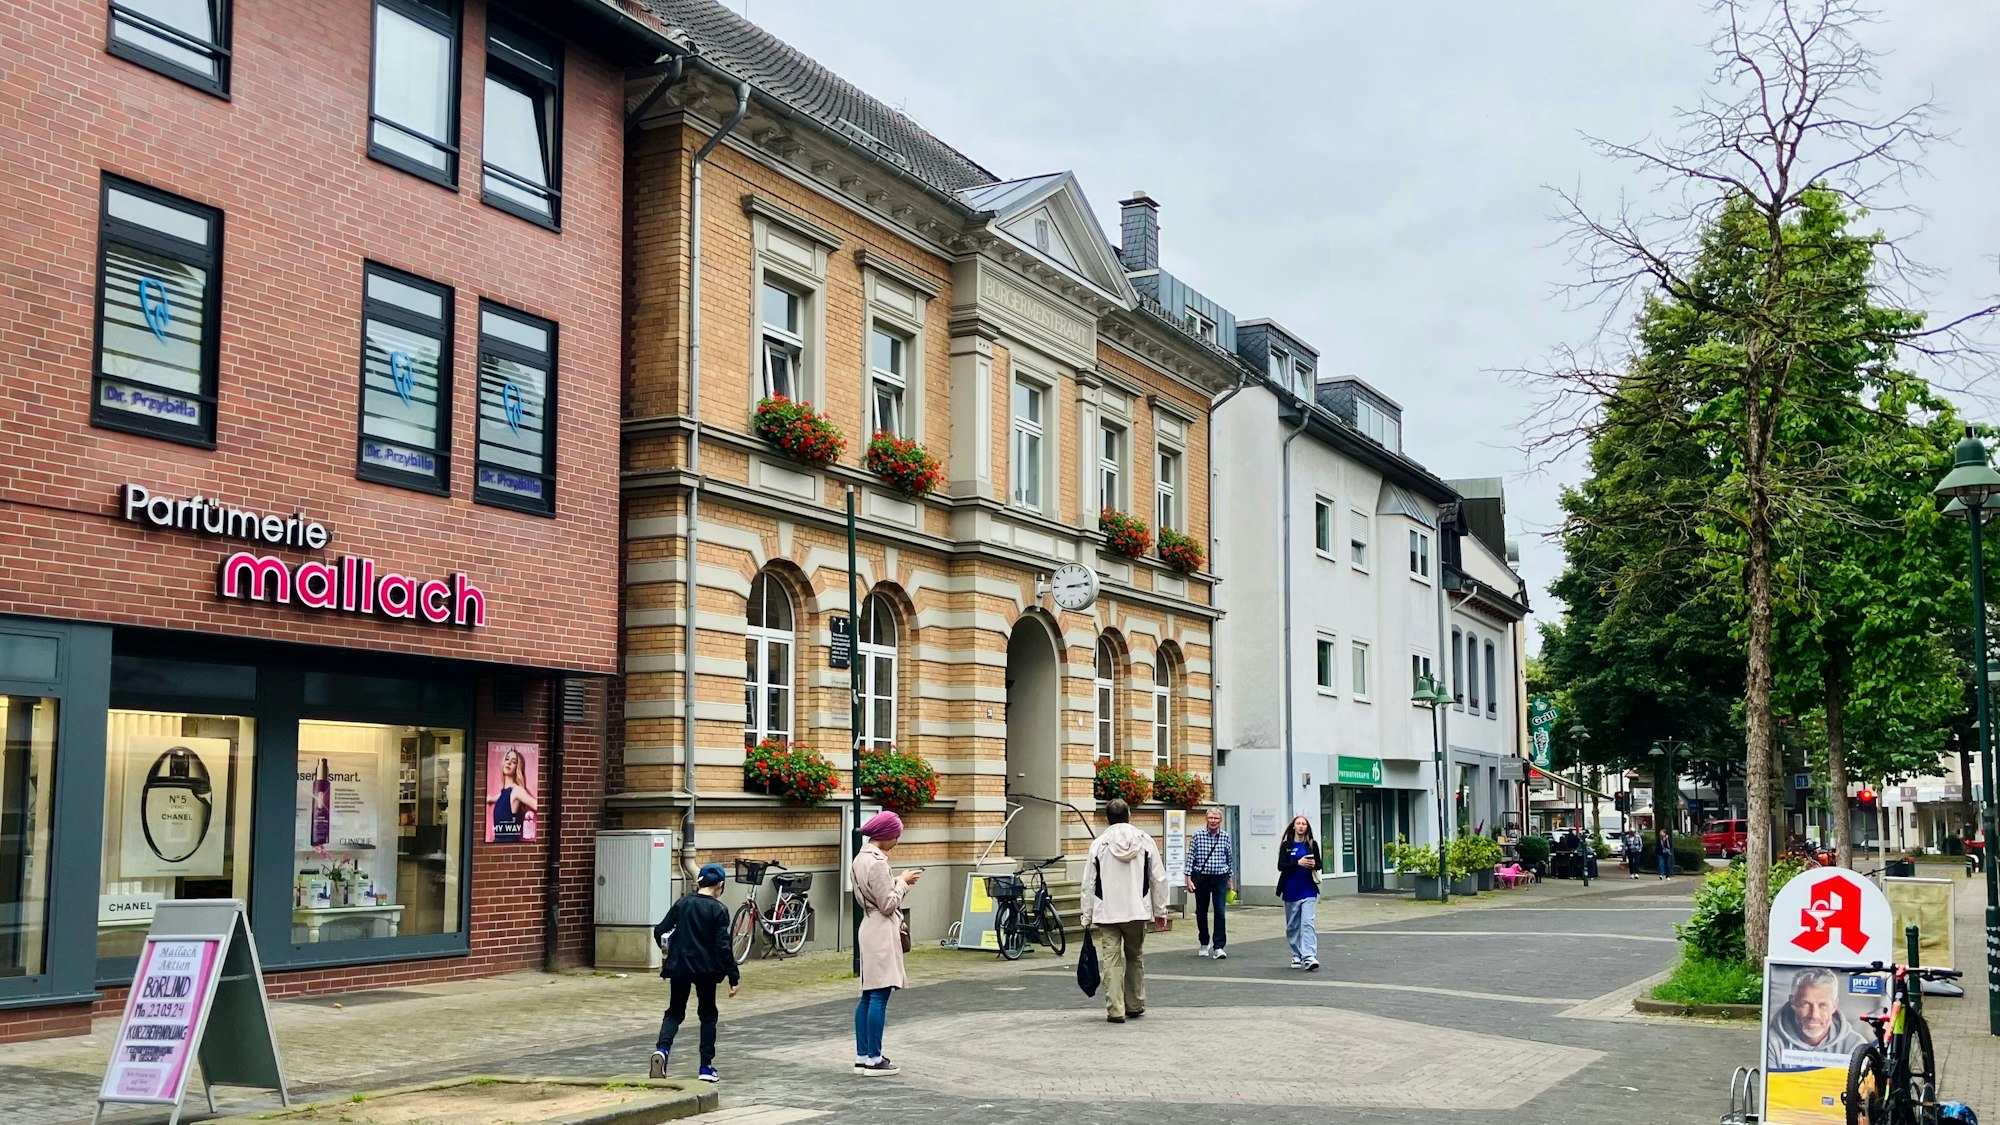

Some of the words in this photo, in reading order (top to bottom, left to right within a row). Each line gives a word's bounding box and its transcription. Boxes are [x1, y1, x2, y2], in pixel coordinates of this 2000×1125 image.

[104, 385, 128, 404] Dr.
[131, 391, 196, 418] Przybilla
[385, 448, 434, 471] Przybilla
[125, 484, 328, 550] Parfümerie
[222, 551, 487, 628] mallach
[1533, 710, 1557, 725] Grill
[328, 772, 361, 782] smart.
[161, 813, 193, 821] CHANEL
[505, 824, 522, 832] WAY
[108, 902, 153, 912] CHANEL
